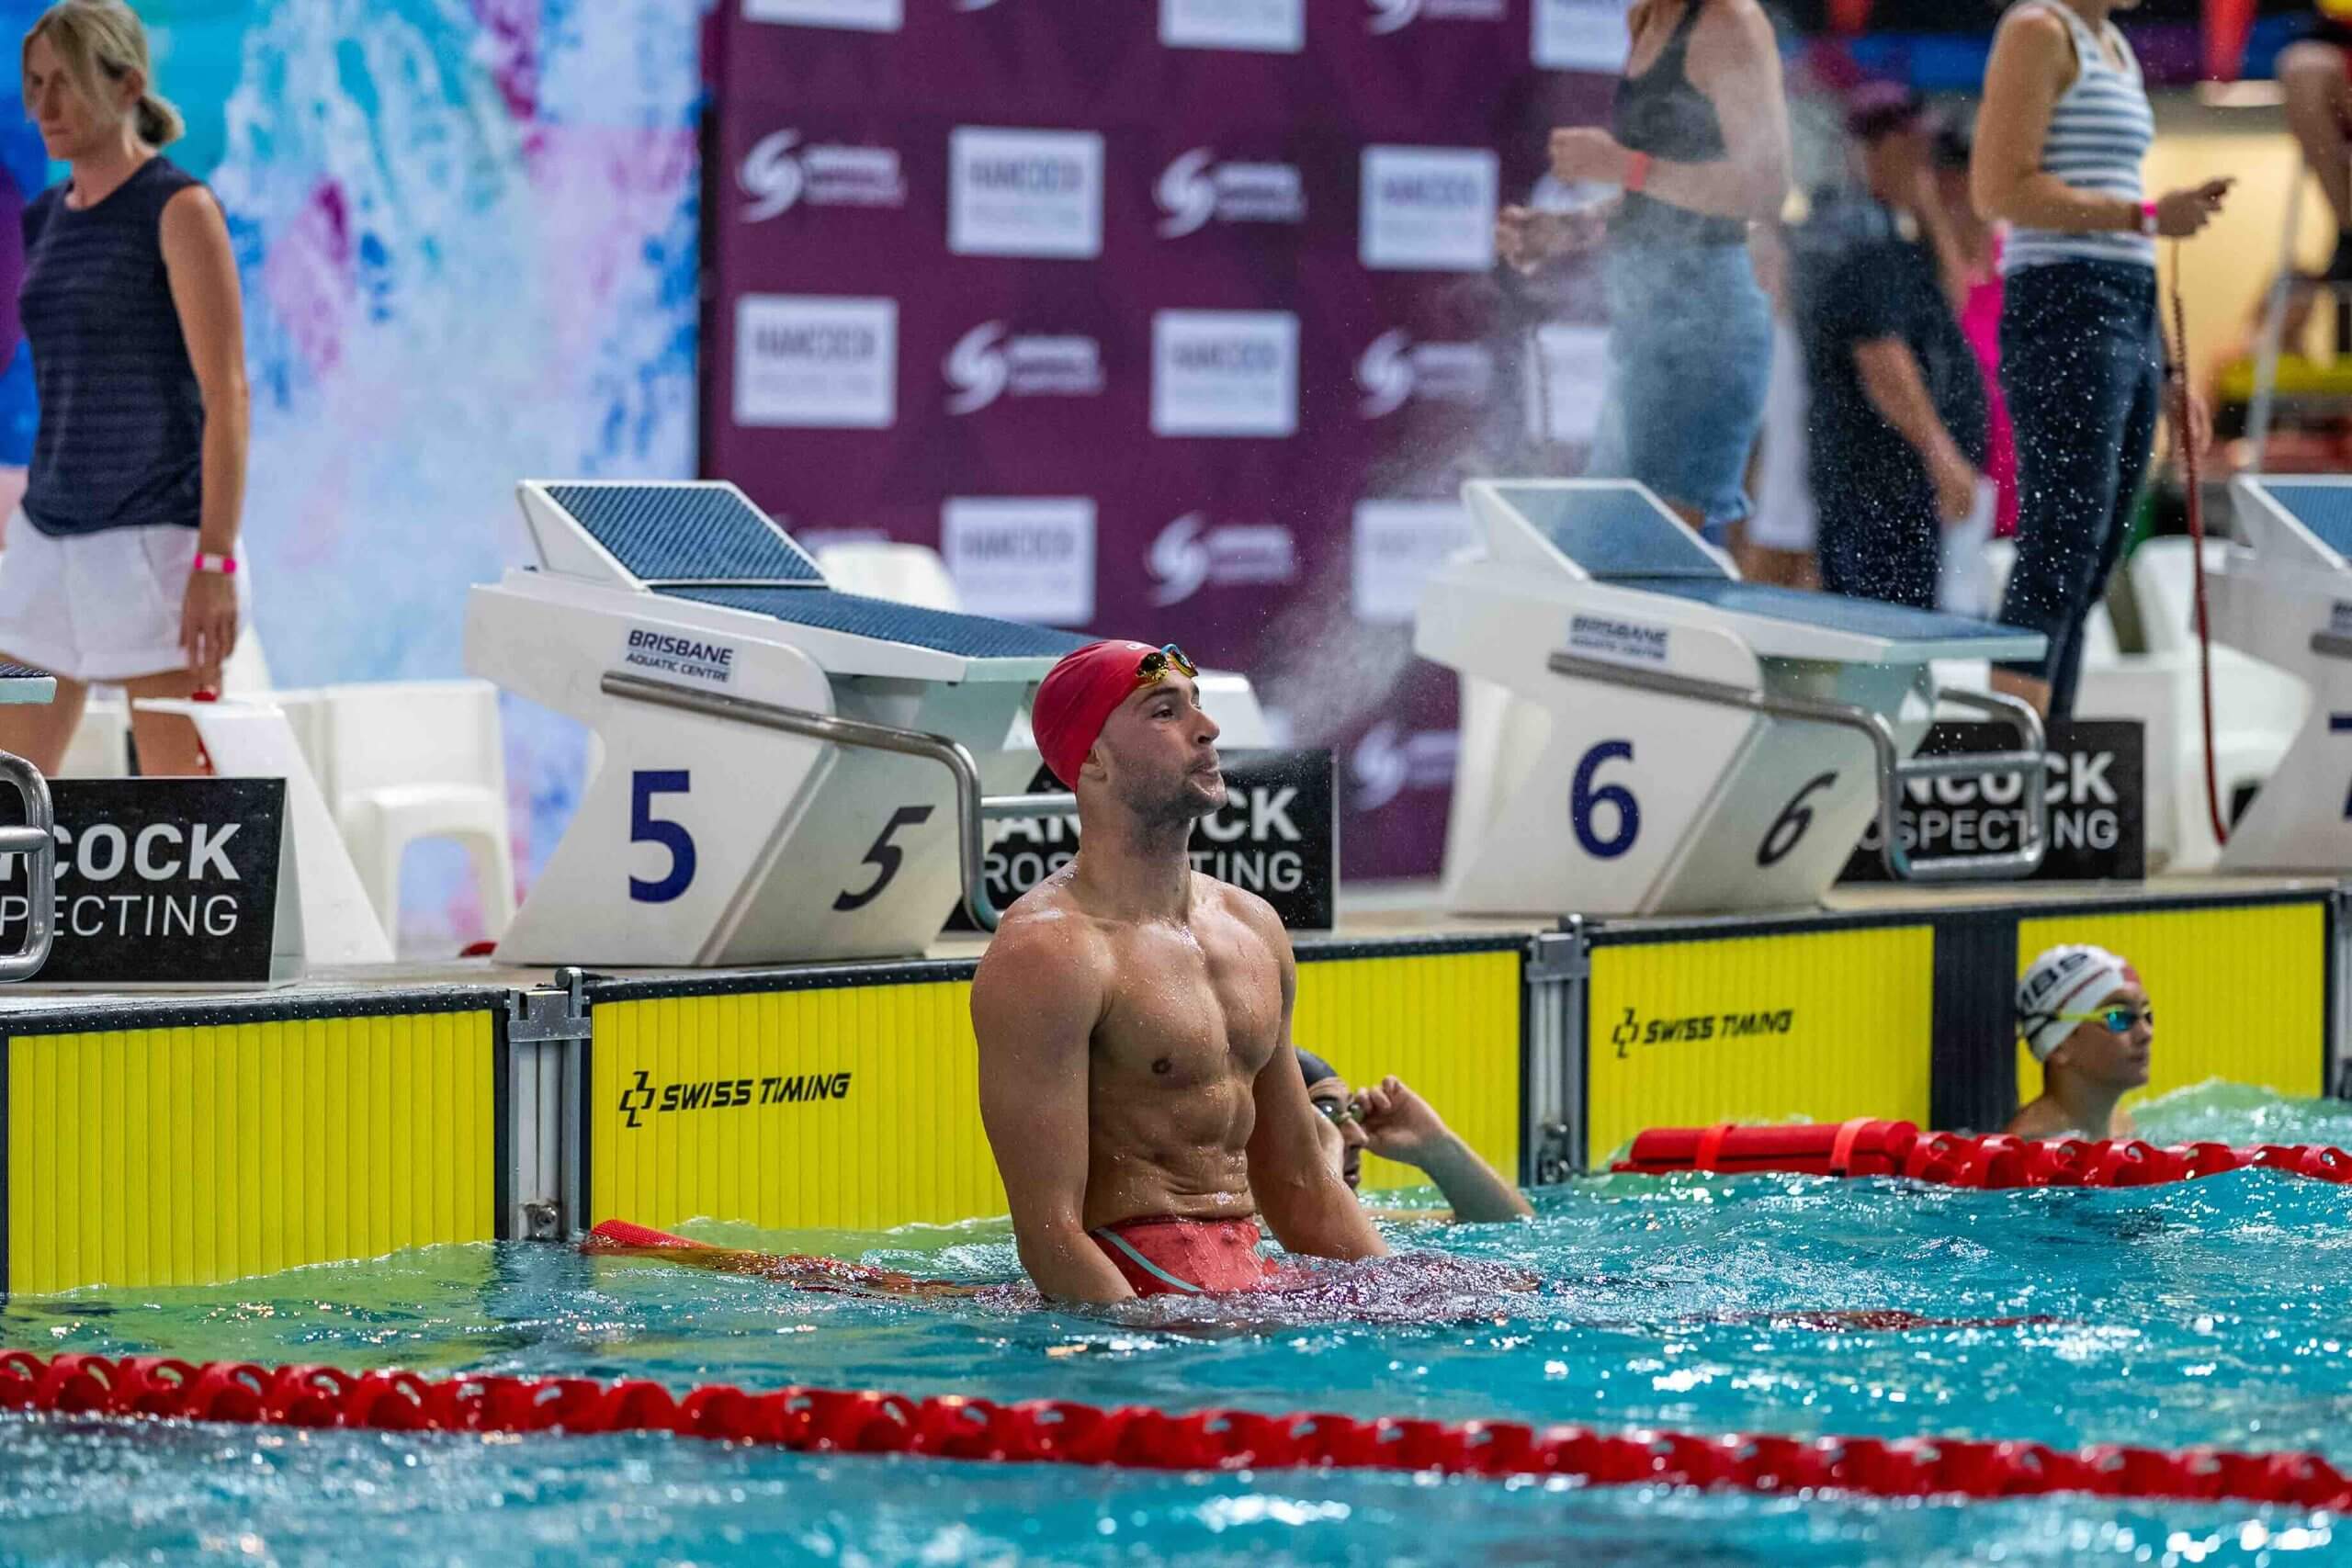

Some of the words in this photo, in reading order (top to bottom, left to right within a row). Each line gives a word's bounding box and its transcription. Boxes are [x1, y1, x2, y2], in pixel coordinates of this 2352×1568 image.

[626, 653, 679, 673] AQUATIC
[680, 663, 729, 683] CENTRE
[628, 629, 734, 666] BRISBANE
[1569, 739, 1641, 861] 6
[1756, 771, 1838, 868] 6
[0, 823, 242, 882] COCK
[628, 770, 697, 904] 5
[831, 805, 936, 911] 5
[1643, 1014, 1716, 1045] SWISS
[658, 1078, 754, 1113] SWISS
[759, 1071, 852, 1105] TIMING
